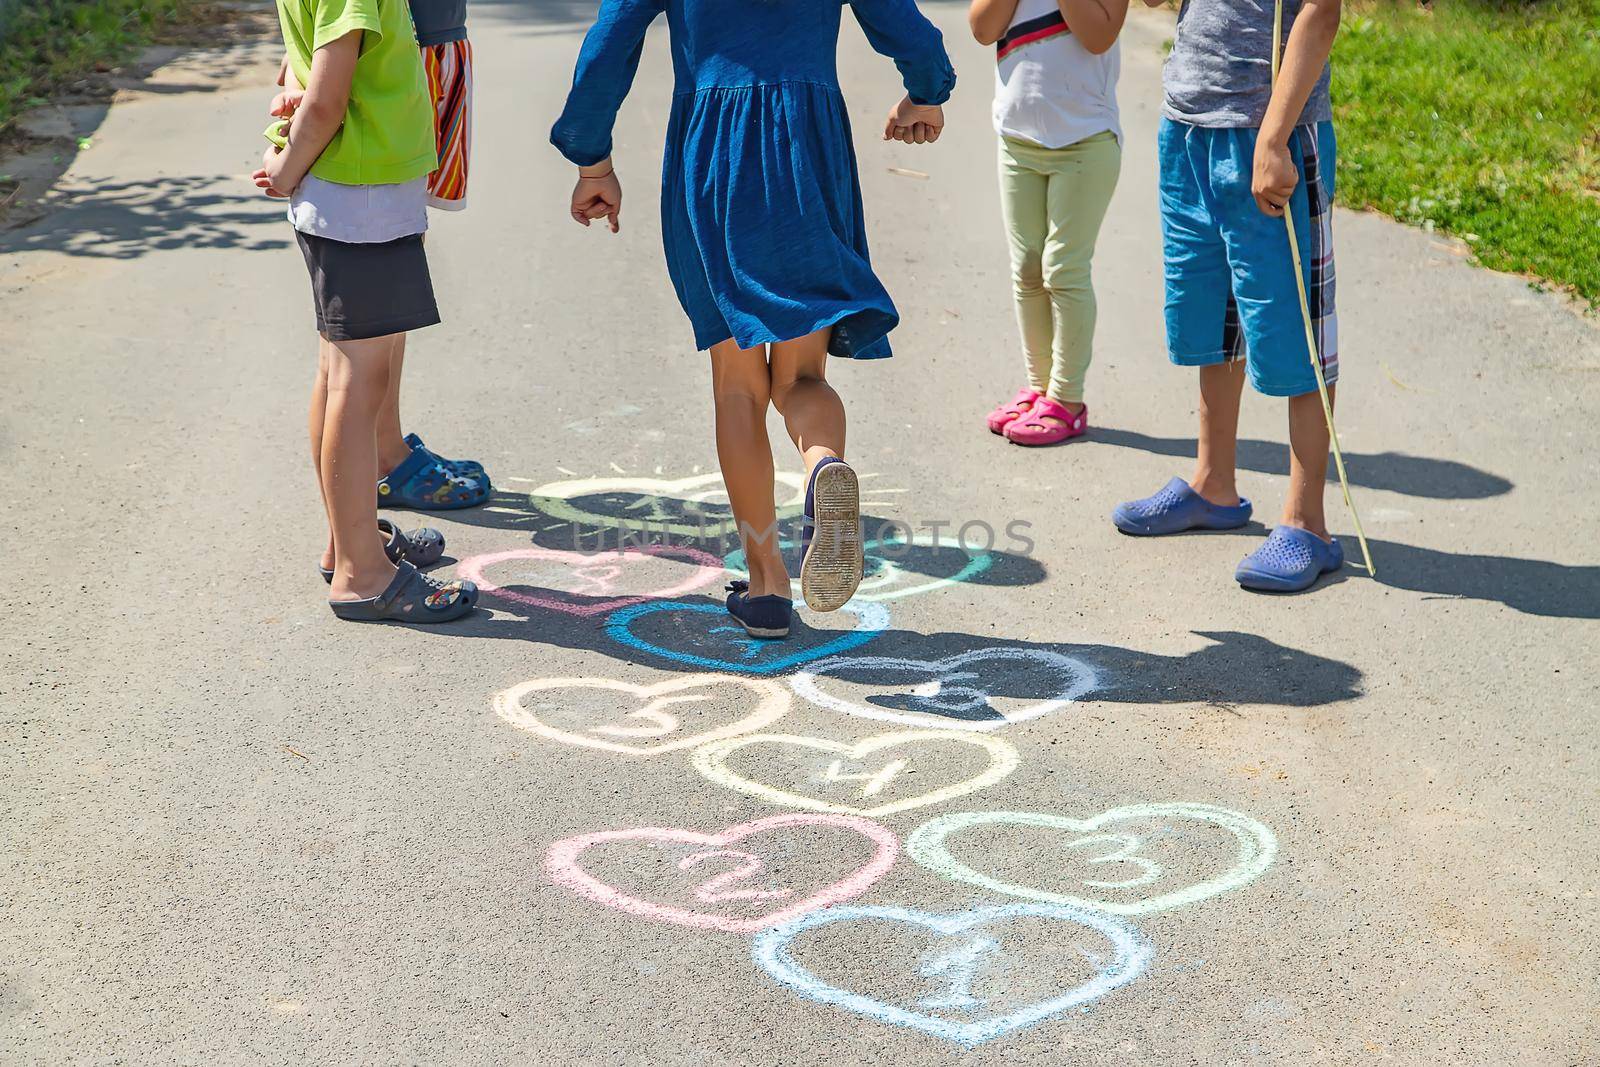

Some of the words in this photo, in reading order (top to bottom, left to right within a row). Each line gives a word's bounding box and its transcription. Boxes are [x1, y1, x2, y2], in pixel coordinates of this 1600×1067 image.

[588, 694, 714, 737] 5
[819, 758, 911, 797] 4
[679, 849, 791, 902] 2
[1066, 832, 1161, 889] 3
[918, 939, 999, 1008] 1
